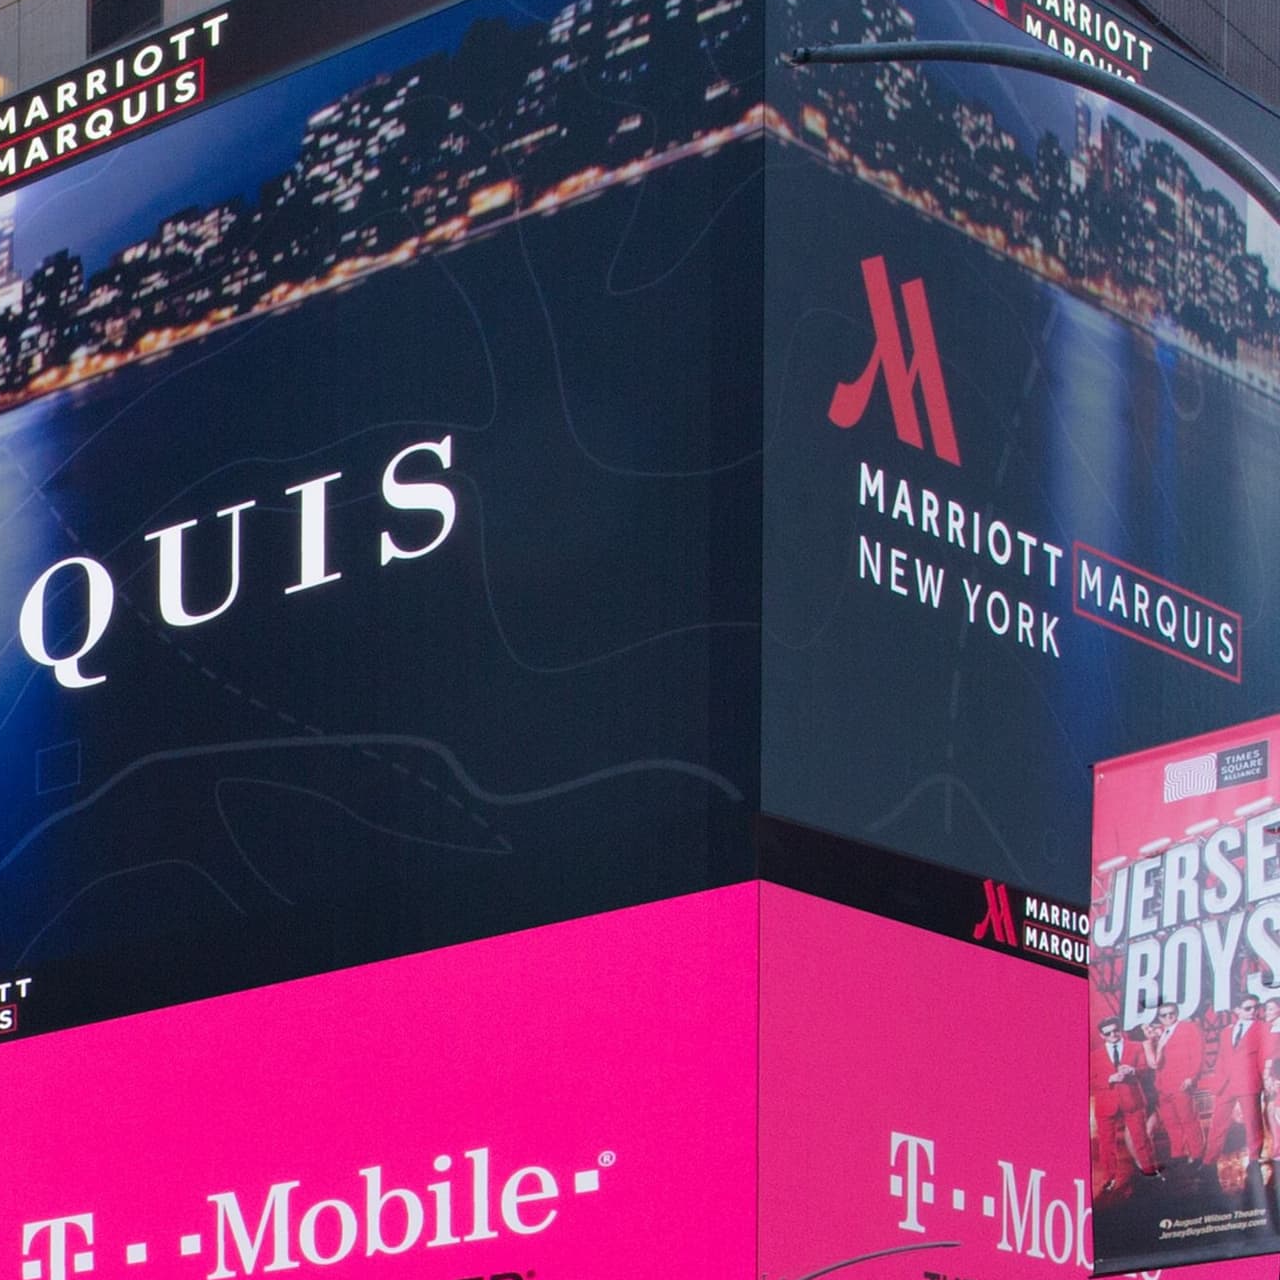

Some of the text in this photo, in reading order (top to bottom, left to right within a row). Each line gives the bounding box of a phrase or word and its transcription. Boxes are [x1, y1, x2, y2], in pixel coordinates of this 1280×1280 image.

[859, 462, 1235, 664] MARRIOTT MARQUIS
[859, 535, 1060, 658] NEW YORK
[1221, 757, 1263, 775] SQUARE
[1223, 767, 1261, 781] ALLIANCE
[1225, 749, 1260, 764] TIMES
[1093, 807, 1280, 948] JERSE
[1026, 896, 1089, 935] MARRIO
[1026, 926, 1090, 965] MARQUI
[1124, 903, 1280, 1032] BOYS
